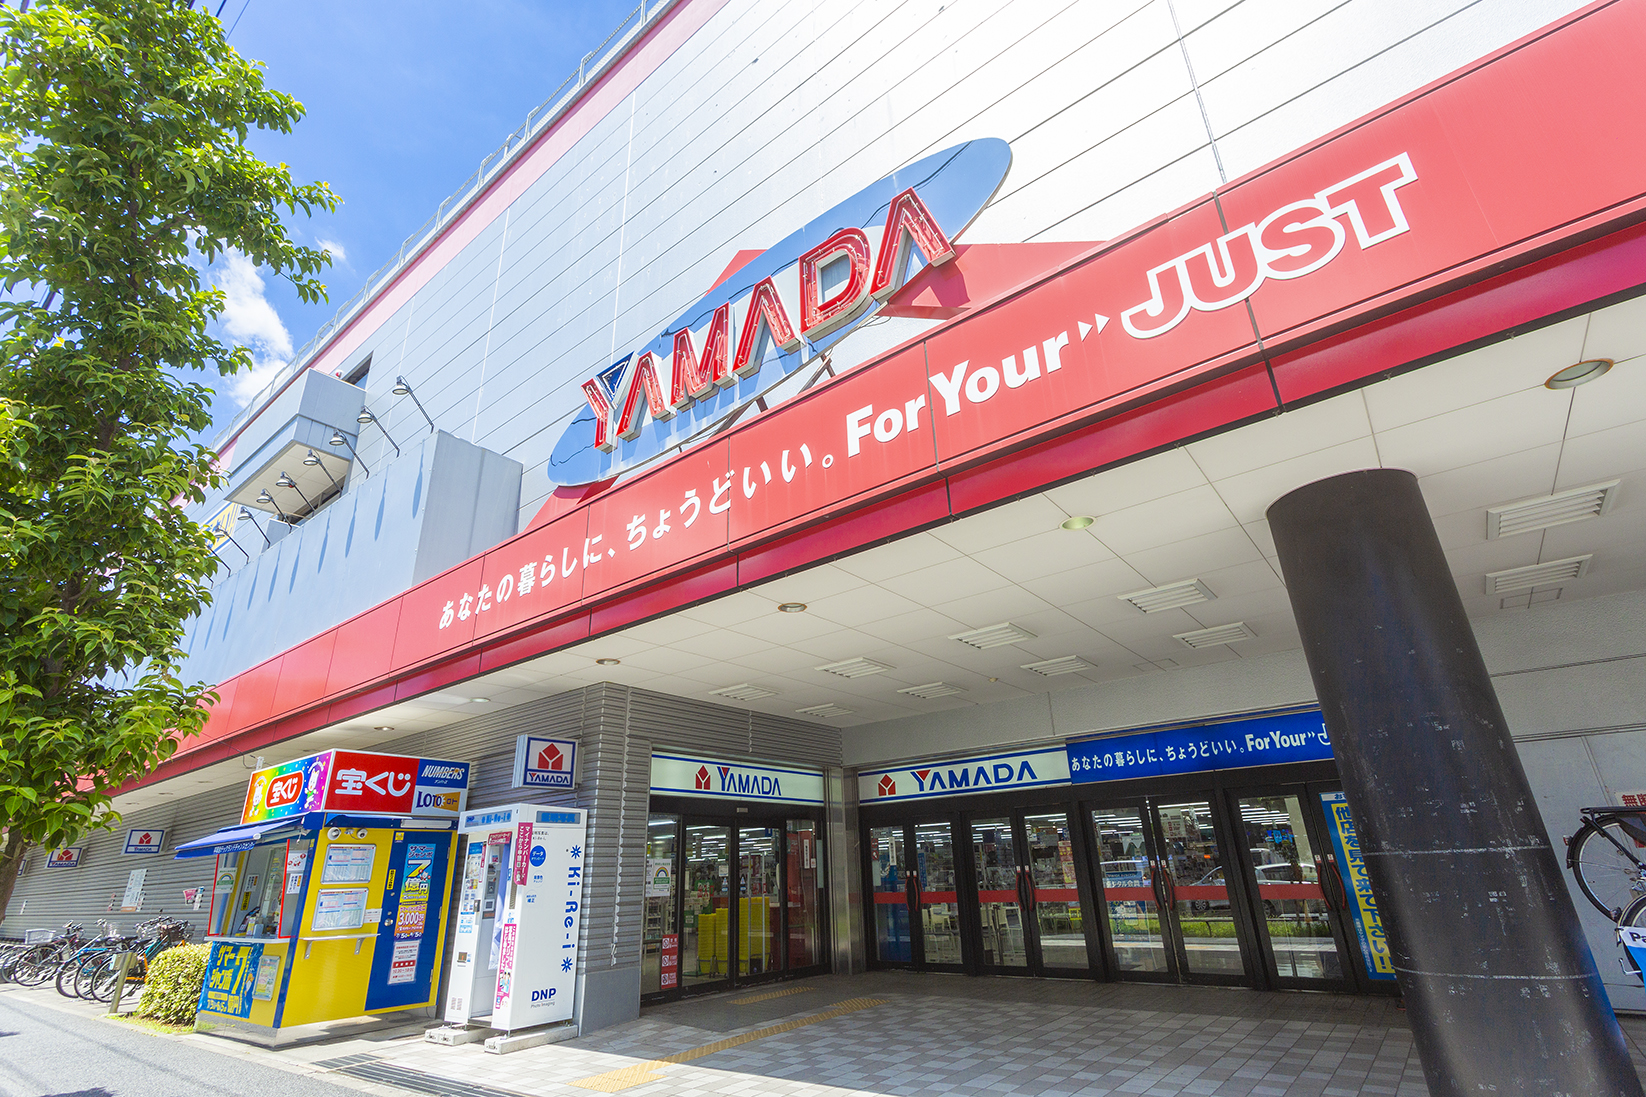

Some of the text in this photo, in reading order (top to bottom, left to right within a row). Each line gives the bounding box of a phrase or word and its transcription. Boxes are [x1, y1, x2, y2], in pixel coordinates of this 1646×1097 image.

[581, 187, 956, 453] YAMADA
[438, 152, 1418, 629] あなたの暮らしに、ちょうどいい。 For Your JUST
[1071, 738, 1244, 772] あなたの暮らしに、ちょうどいい。
[1245, 733, 1270, 752] For
[1269, 730, 1306, 749] Your
[335, 766, 412, 796] 宝くじ
[421, 764, 465, 780] NUMBERS
[528, 772, 570, 785] YAMADA
[717, 766, 781, 796] YAMADA
[910, 760, 1038, 792] YAMADA
[269, 777, 299, 804] 宝くじ
[416, 790, 442, 809] LOTO
[562, 866, 581, 950] Ki-Re-i
[216, 945, 236, 967] サマー
[209, 967, 234, 991] ジャンボ
[531, 987, 557, 1001] DNP
